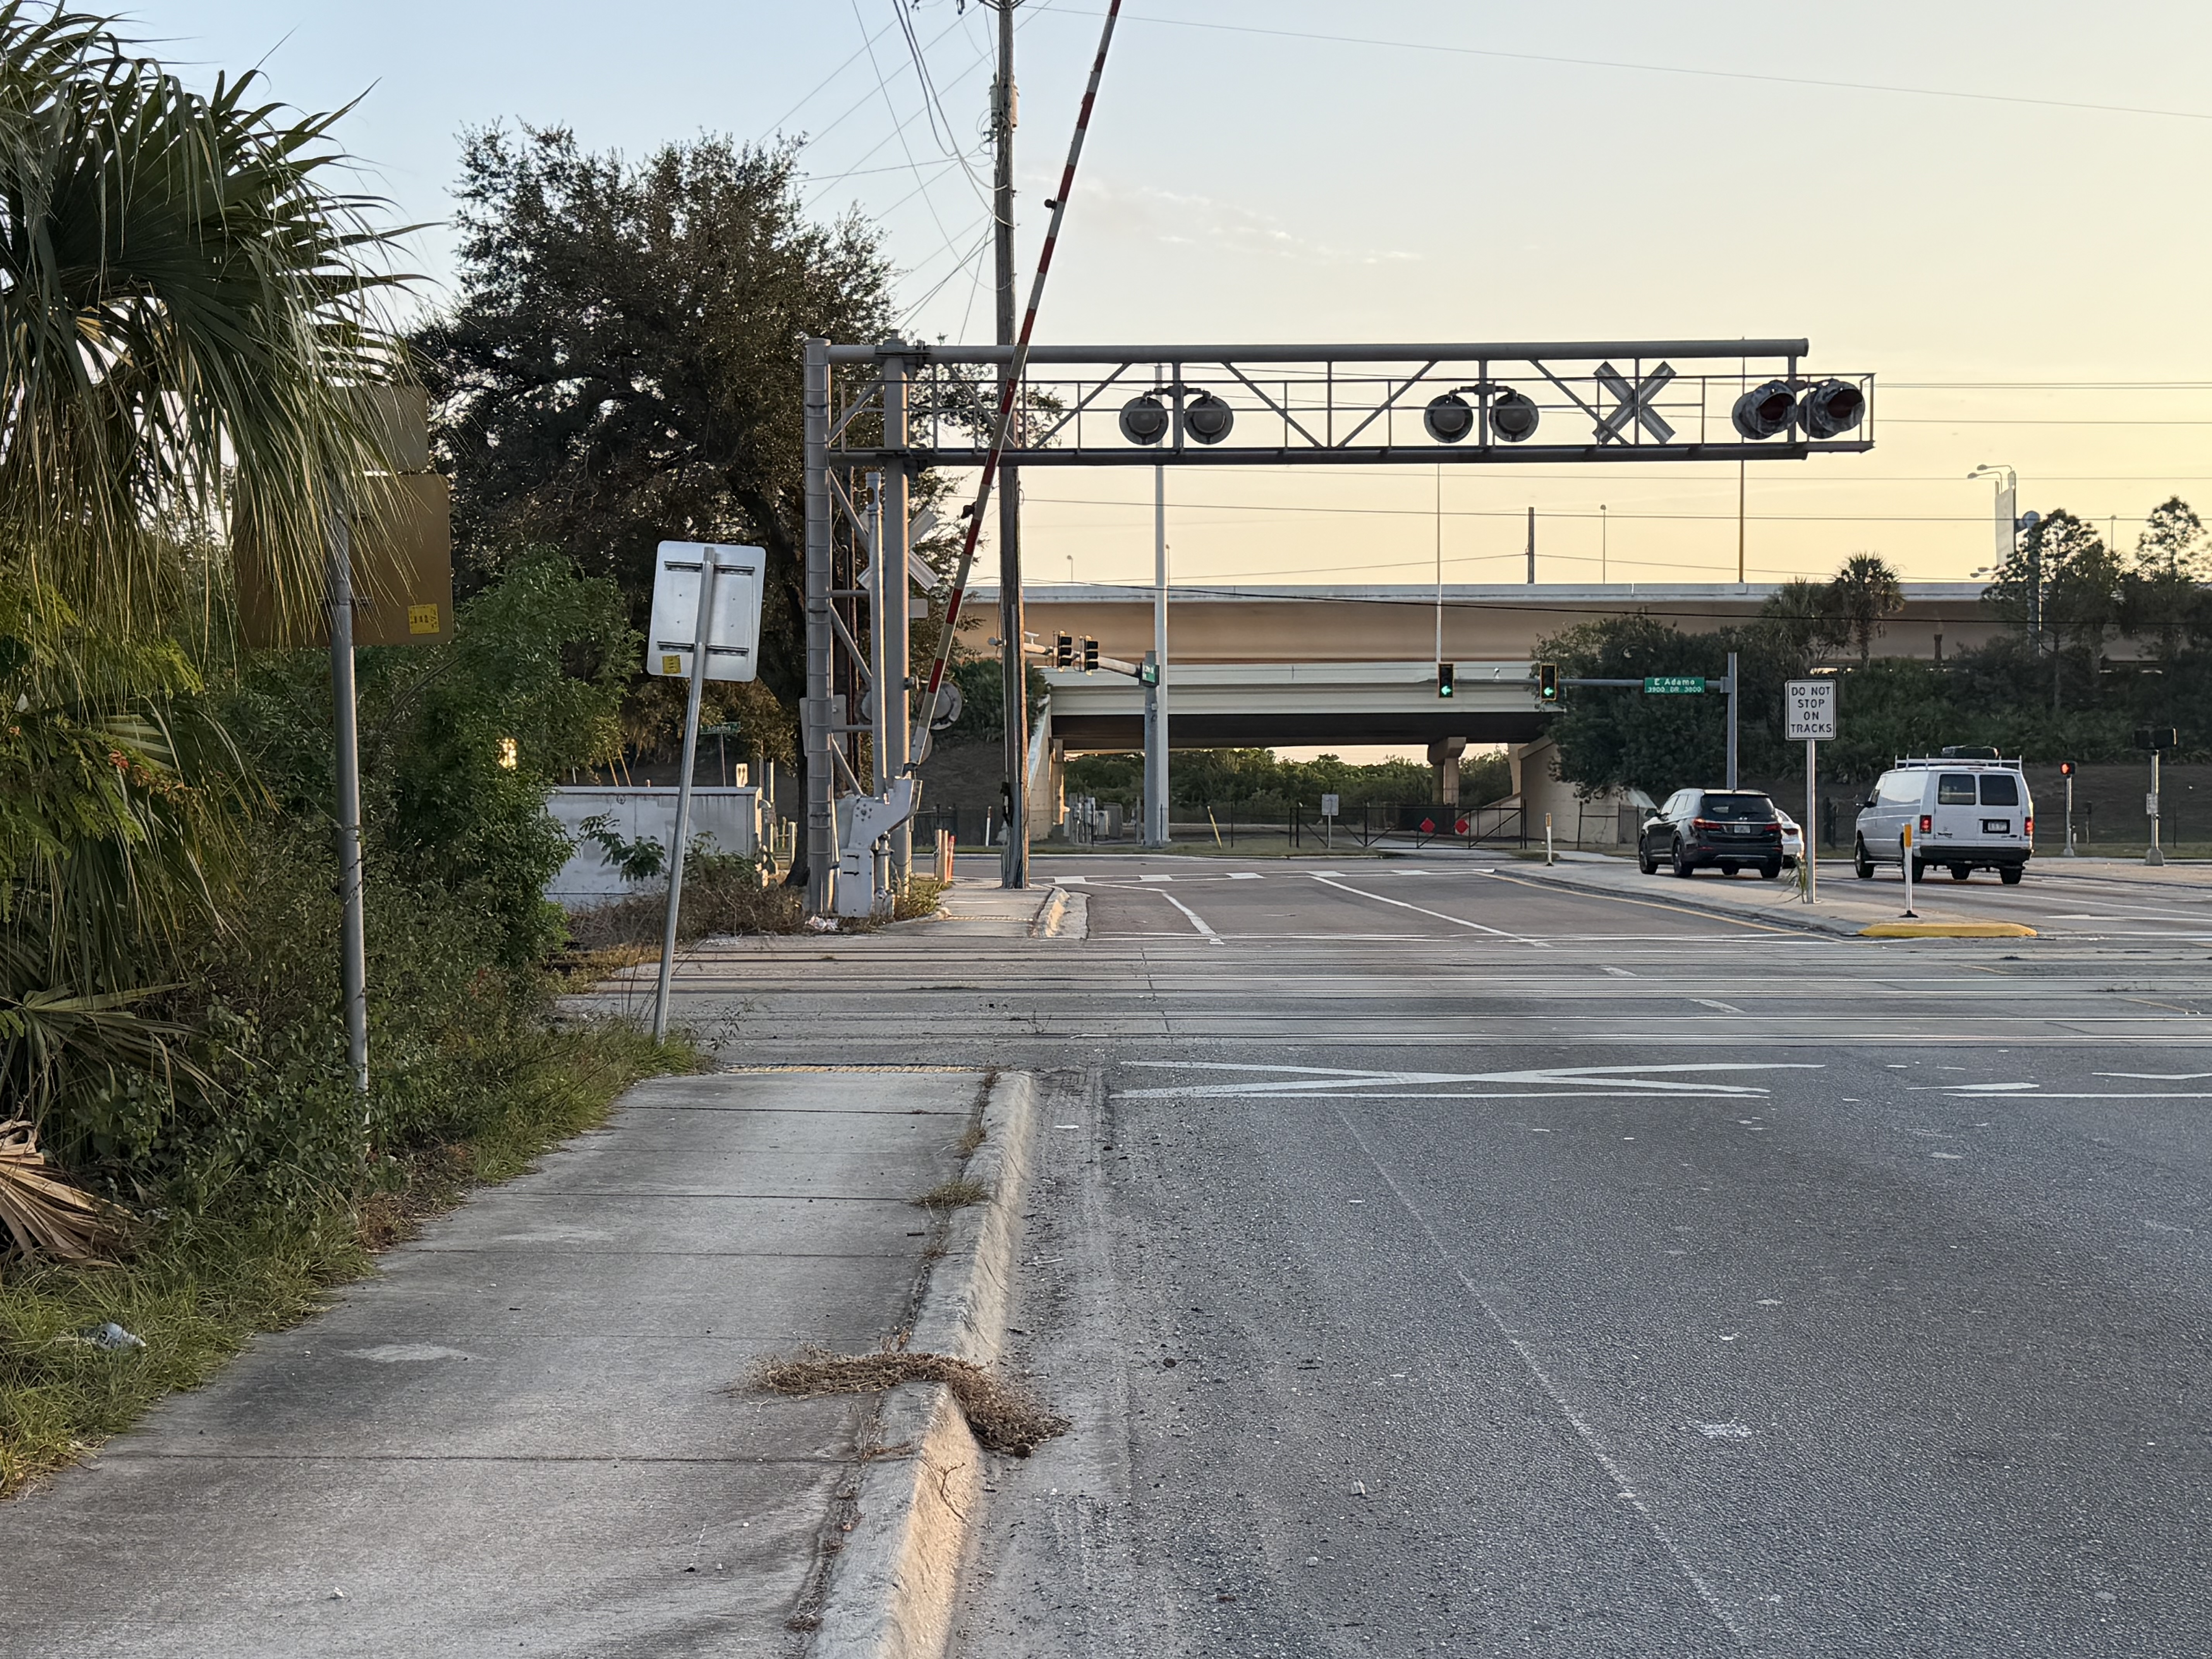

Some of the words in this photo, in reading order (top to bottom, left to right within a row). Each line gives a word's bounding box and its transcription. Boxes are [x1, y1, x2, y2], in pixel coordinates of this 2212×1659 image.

[1791, 687, 1805, 696] DO
[1811, 687, 1831, 696] NOT
[1797, 699, 1825, 708] STOP
[1803, 711, 1819, 720] ON
[1791, 724, 1832, 733] TRACKS
